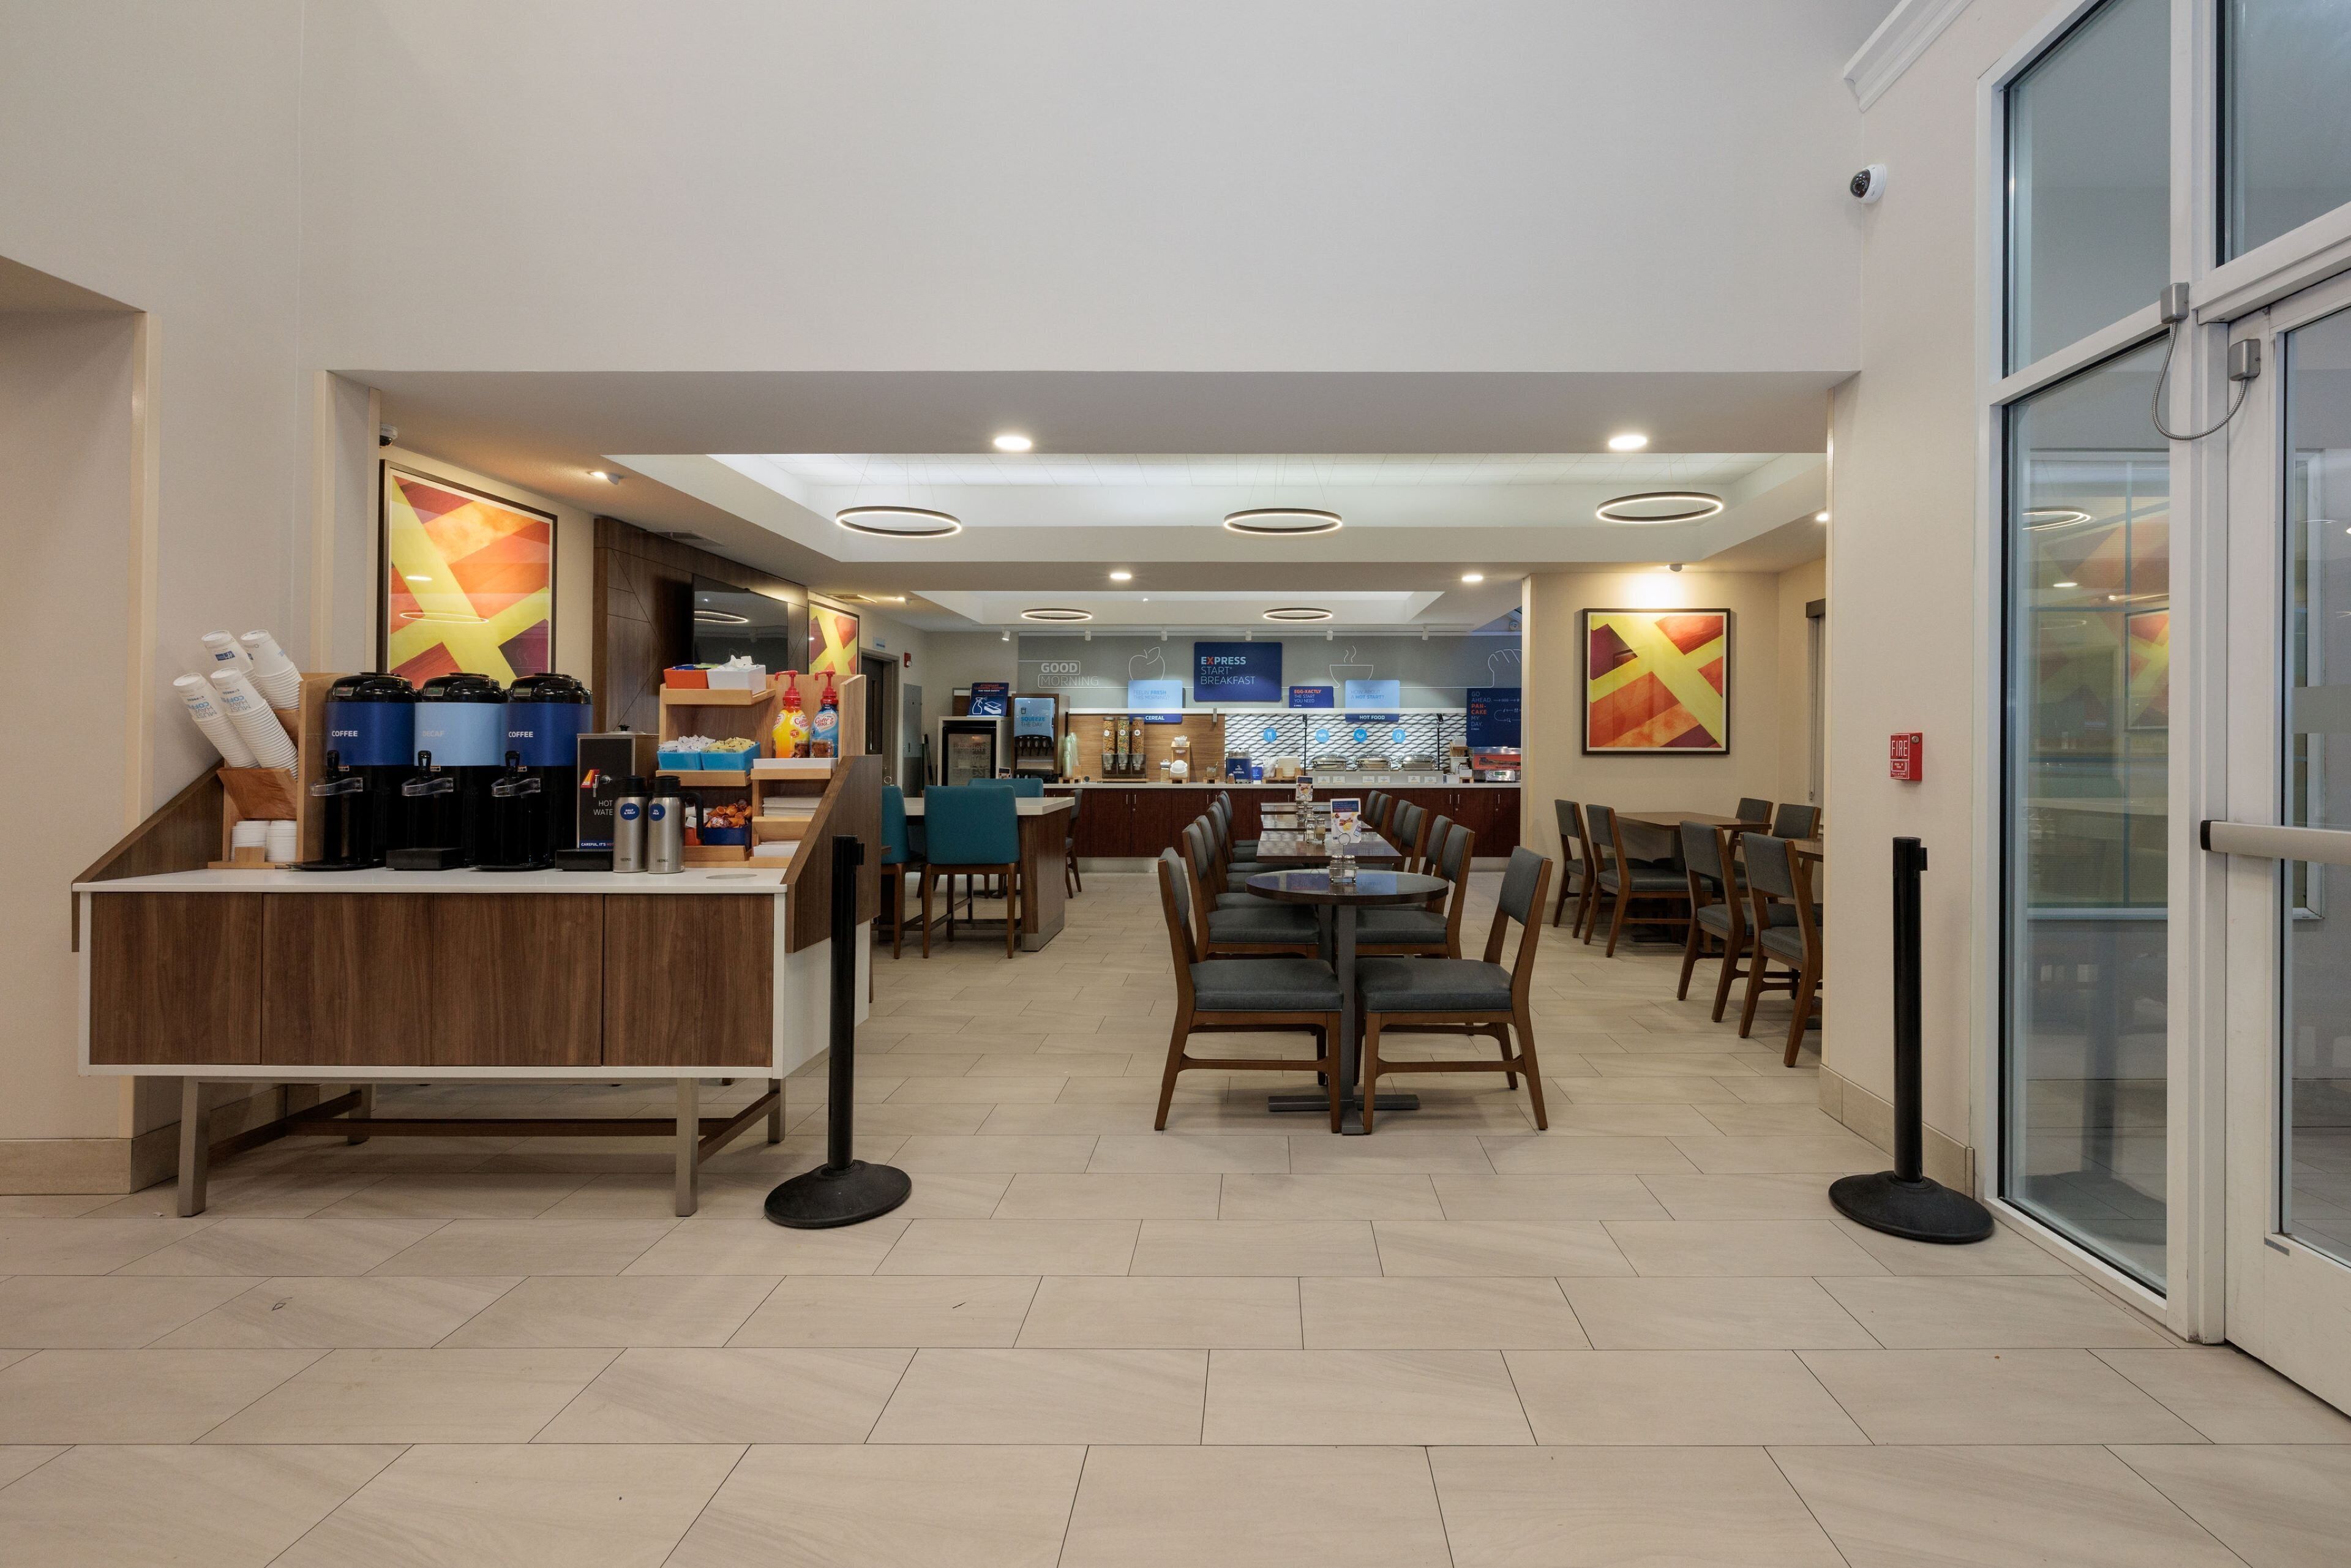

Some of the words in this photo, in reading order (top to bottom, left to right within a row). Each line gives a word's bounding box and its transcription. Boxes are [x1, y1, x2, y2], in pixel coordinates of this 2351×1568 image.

[1201, 656, 1247, 665] EXPRESS
[1041, 662, 1078, 673] GOOD
[1041, 675, 1099, 686] MORNING
[1201, 676, 1256, 685] BREAKFAST
[1892, 740, 1908, 756] FIRE
